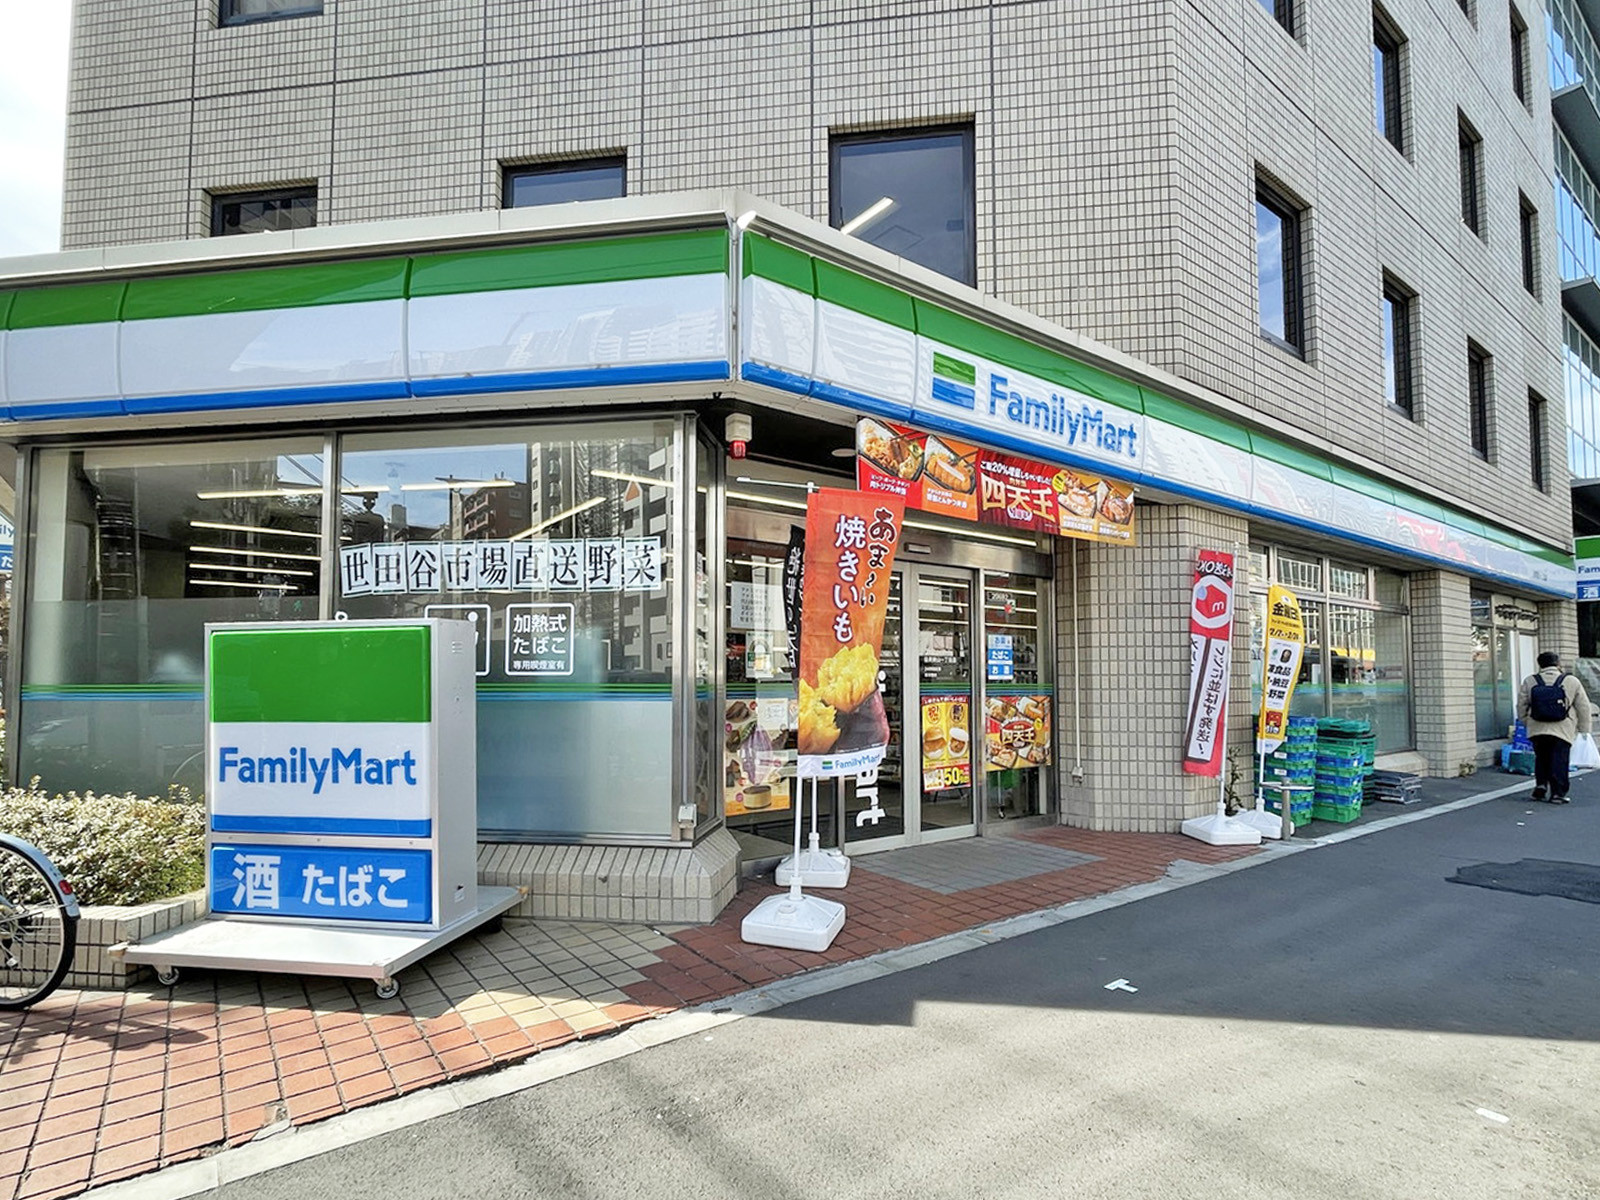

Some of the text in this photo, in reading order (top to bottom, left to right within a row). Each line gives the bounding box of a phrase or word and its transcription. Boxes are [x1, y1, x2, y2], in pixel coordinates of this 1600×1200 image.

[989, 373, 1137, 457] FamilyMart
[981, 472, 1056, 523] 四天王
[342, 543, 656, 592] 世田谷市場直送野菜
[833, 514, 867, 643] 焼きいも
[513, 613, 568, 633] 加熱式
[513, 636, 567, 655] たばこ
[219, 746, 417, 795] FamilyMart
[232, 852, 409, 910] 酒 たばこ
